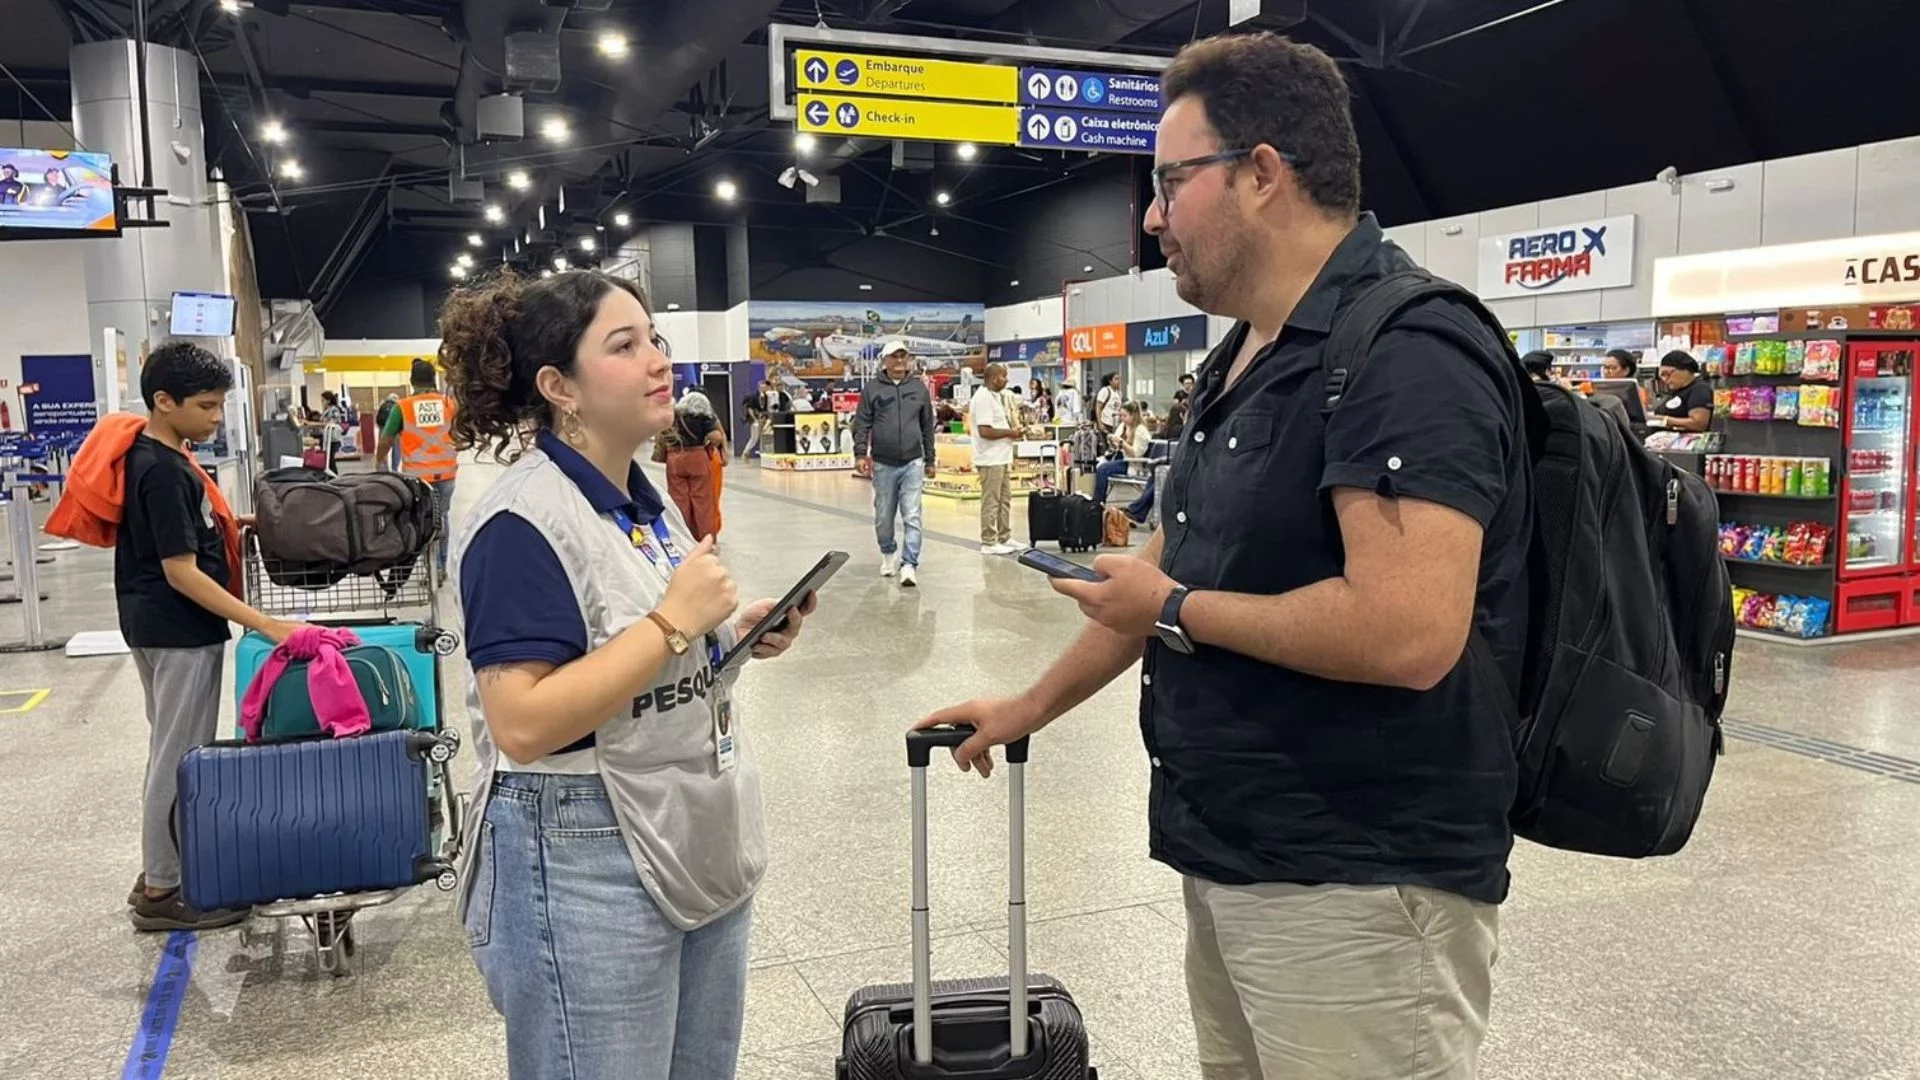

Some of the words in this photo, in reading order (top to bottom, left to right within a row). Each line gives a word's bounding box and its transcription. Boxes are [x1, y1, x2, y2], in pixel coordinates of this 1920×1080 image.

[866, 59, 925, 75] Embarque
[866, 76, 926, 91] Departures
[1108, 78, 1160, 92] Sanitários
[1108, 94, 1159, 108] Restrooms
[866, 110, 916, 124] Check-in
[1081, 116, 1109, 128] Caixa
[1081, 132, 1105, 144] Cash
[1106, 134, 1147, 147] machine
[1508, 230, 1576, 259] AERO
[1505, 251, 1590, 284] FARMA
[1072, 332, 1093, 353] GOL
[1144, 326, 1169, 347] Azul
[419, 403, 437, 412] AST
[419, 413, 441, 424] 0006
